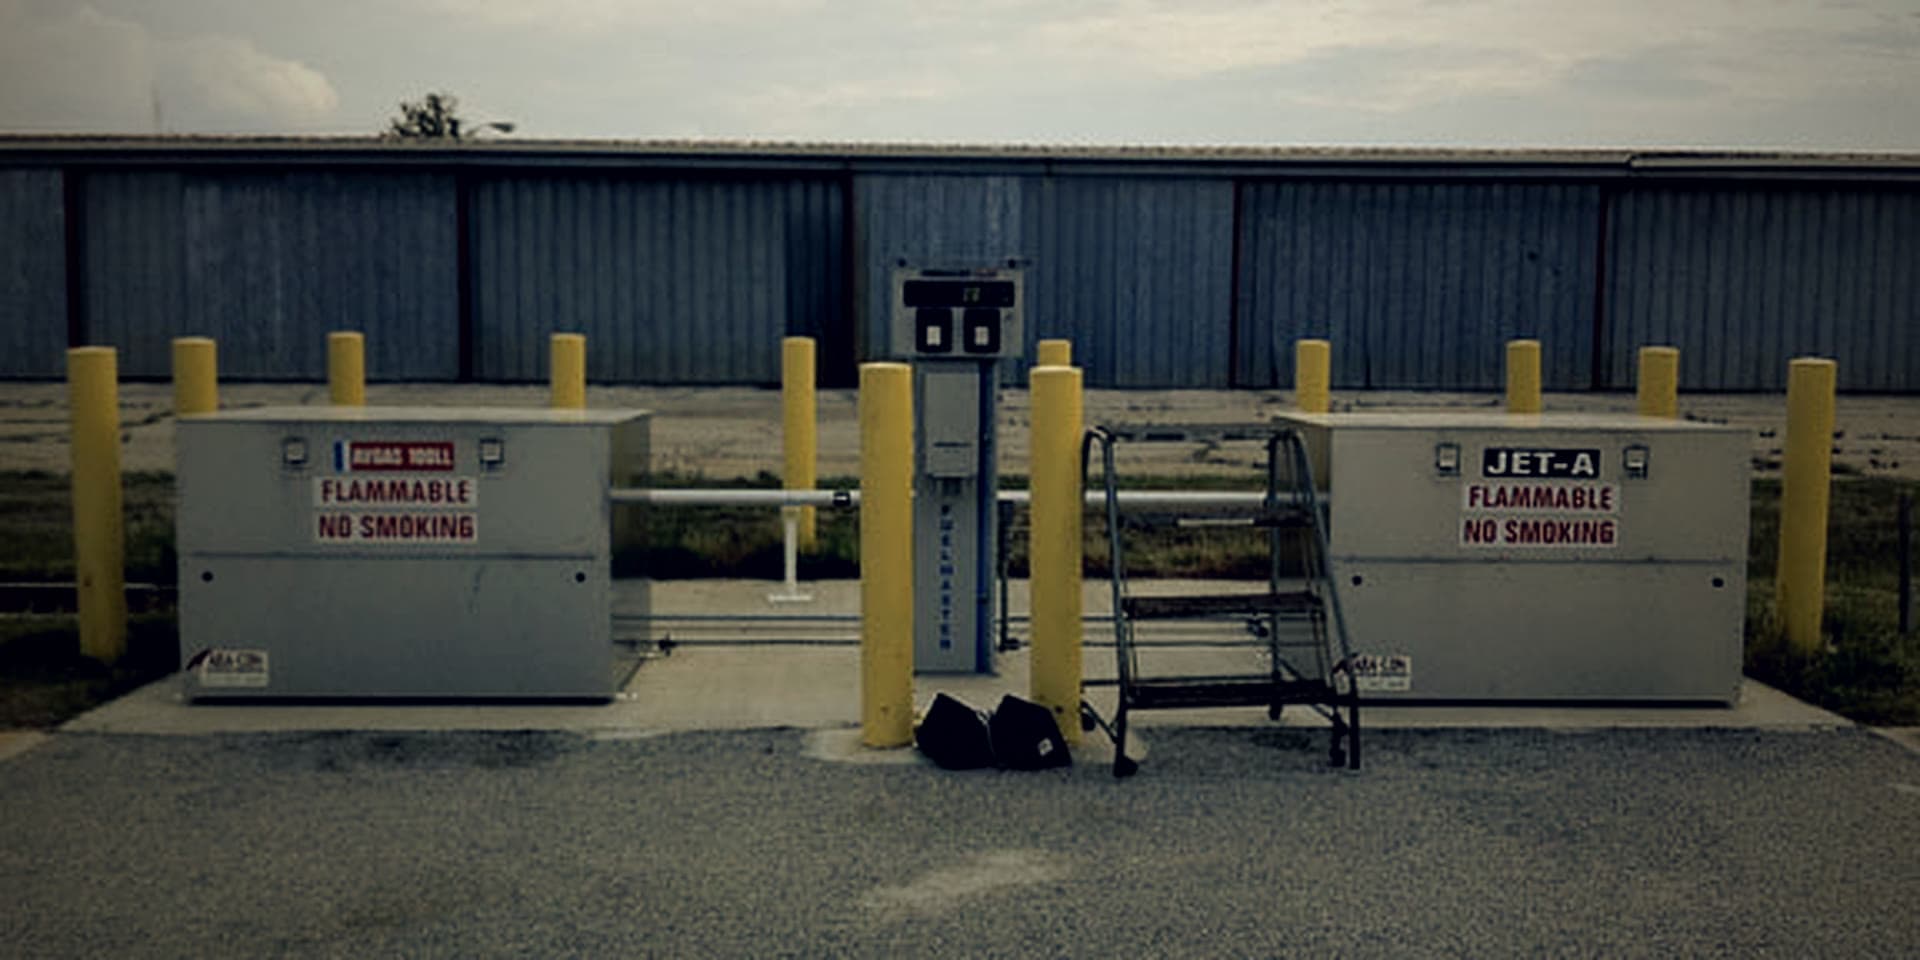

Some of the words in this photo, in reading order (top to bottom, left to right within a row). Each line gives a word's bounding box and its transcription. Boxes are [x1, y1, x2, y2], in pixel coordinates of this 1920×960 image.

[1486, 451, 1595, 476] JET-A
[321, 480, 471, 503] FLAMMABLE
[1470, 486, 1613, 510] FLAMMABLE
[319, 515, 351, 538] NO
[360, 515, 475, 538] SMOKING
[1464, 519, 1498, 543] NO
[1505, 520, 1614, 544] SMOKING
